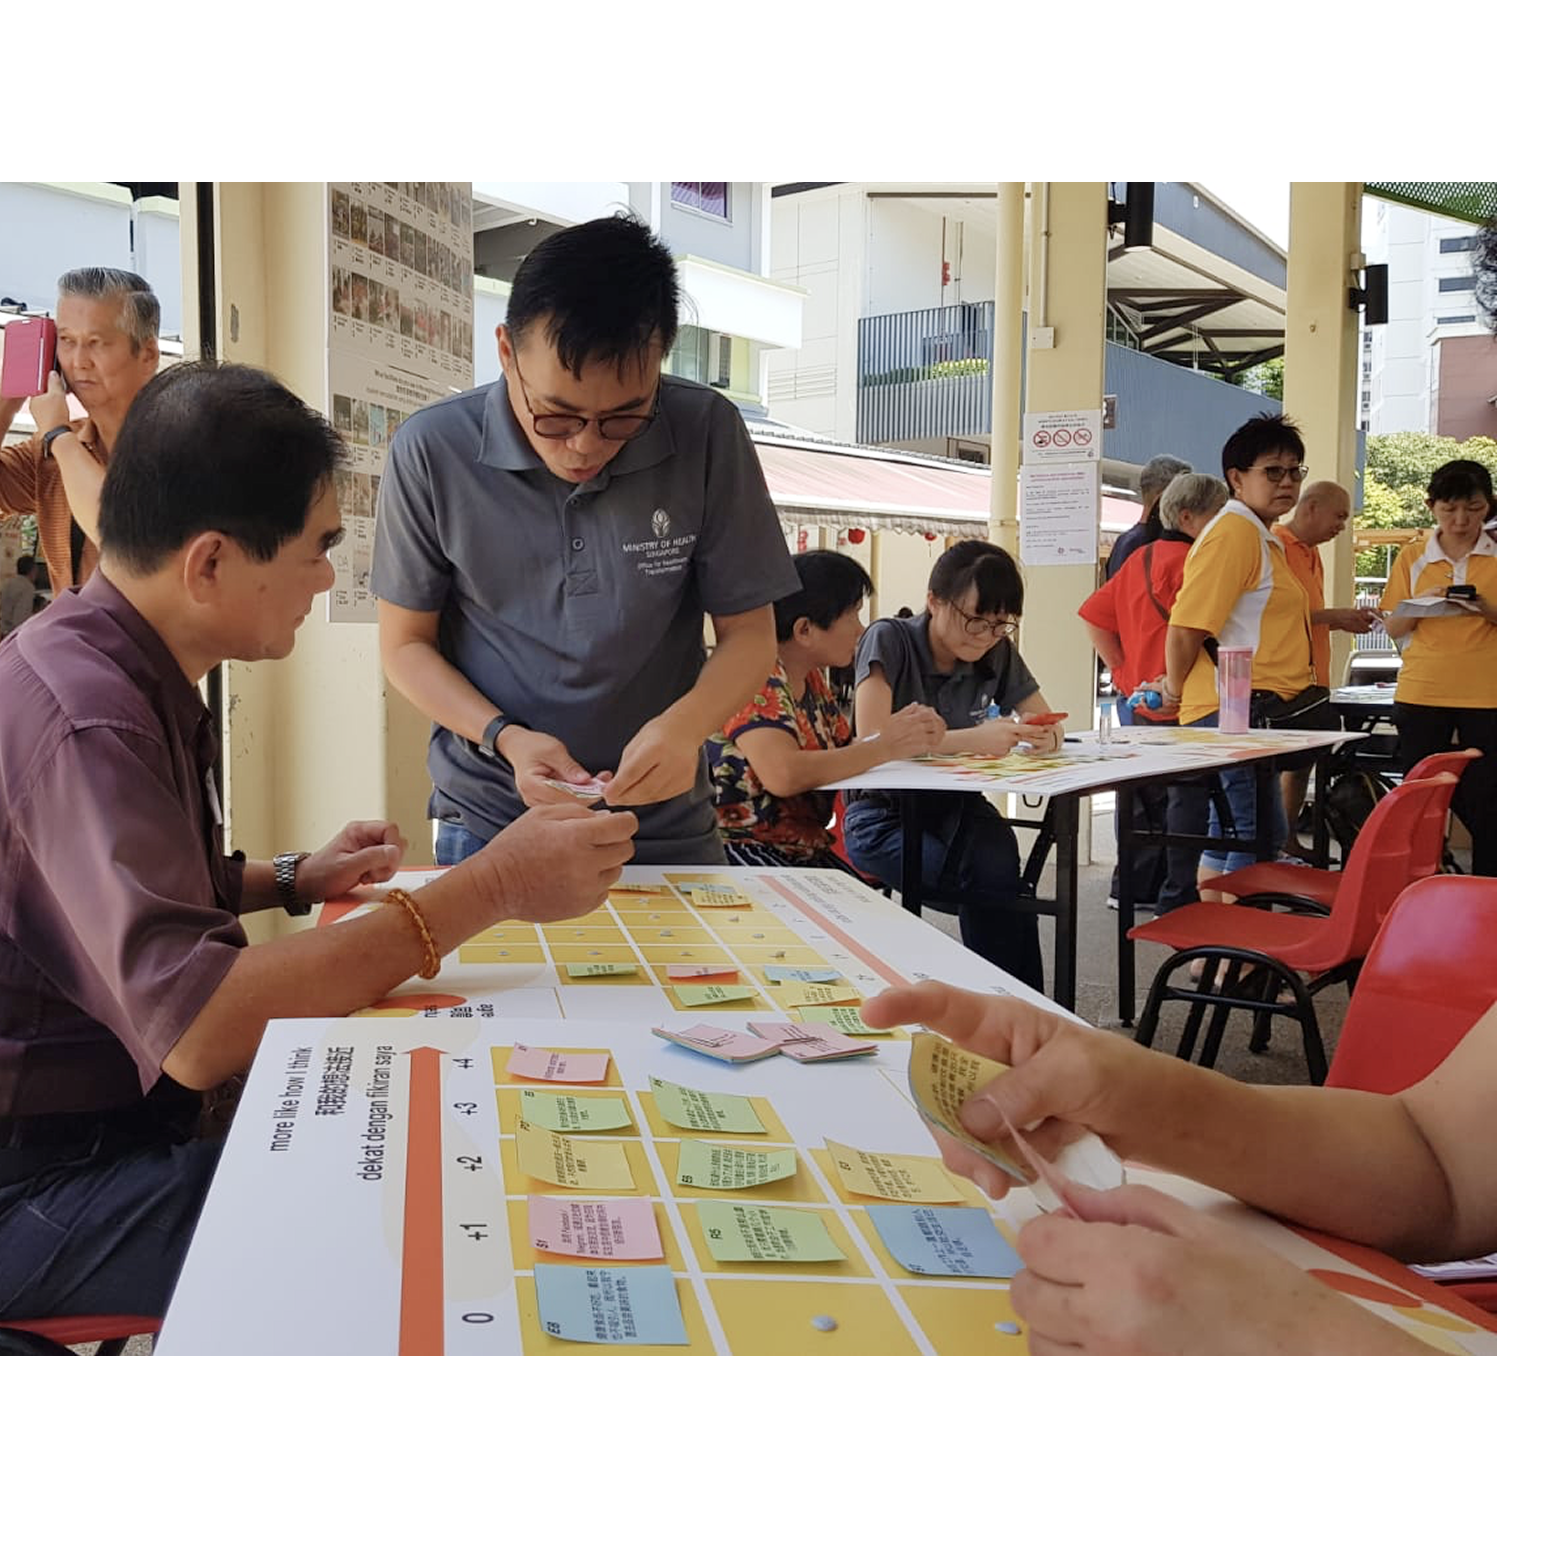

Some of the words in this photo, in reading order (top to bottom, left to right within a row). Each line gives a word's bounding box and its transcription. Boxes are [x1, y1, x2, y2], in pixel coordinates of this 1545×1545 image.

[660, 540, 670, 549] OF
[289, 1047, 312, 1069] think
[376, 1045, 397, 1066] saya
[279, 1076, 304, 1098] how
[366, 1069, 390, 1098] fikiran
[273, 1100, 299, 1118] like
[453, 1102, 478, 1116] +3
[361, 1102, 394, 1141] dengan
[270, 1121, 294, 1151] more
[357, 1144, 385, 1181] dekat
[456, 1155, 483, 1171] +2
[459, 1224, 488, 1241] +1
